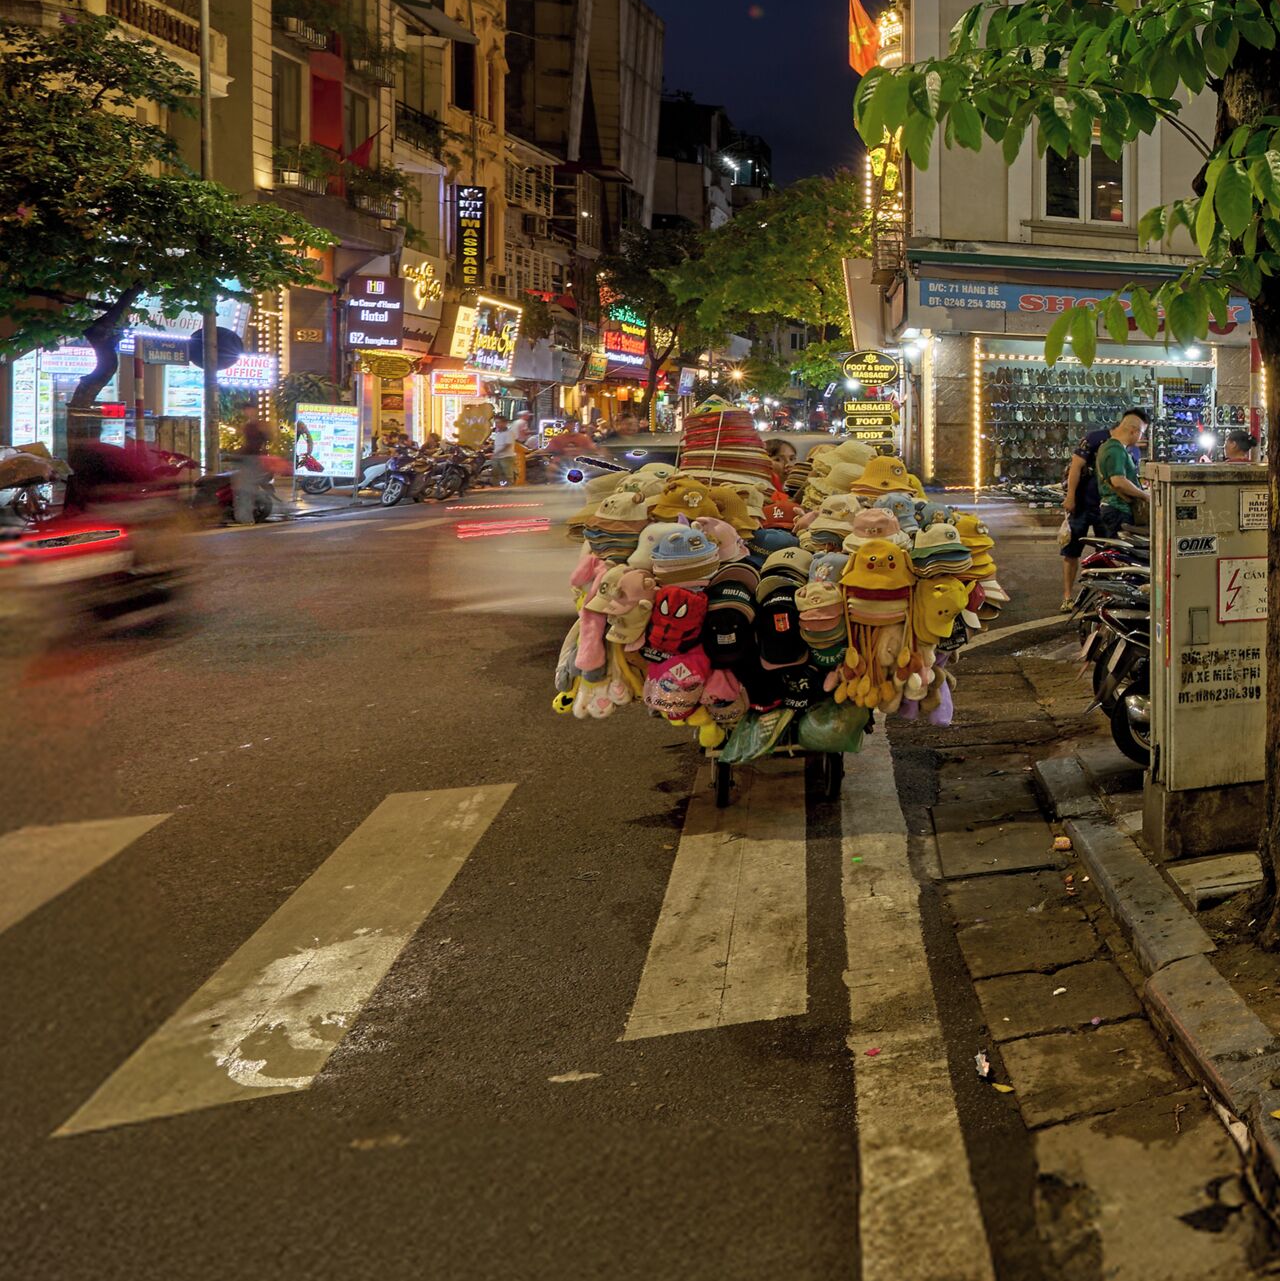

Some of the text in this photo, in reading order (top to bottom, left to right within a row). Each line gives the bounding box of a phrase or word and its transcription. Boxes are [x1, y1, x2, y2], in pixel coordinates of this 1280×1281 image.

[460, 219, 481, 285] MASSAGE
[361, 310, 388, 322] Hotel
[148, 349, 172, 361] HÀNG
[874, 364, 895, 372] BODY
[226, 368, 263, 378] OFFICE
[852, 371, 889, 379] MASSAGE
[847, 403, 891, 411] MASSAGE
[856, 431, 884, 439] BODY
